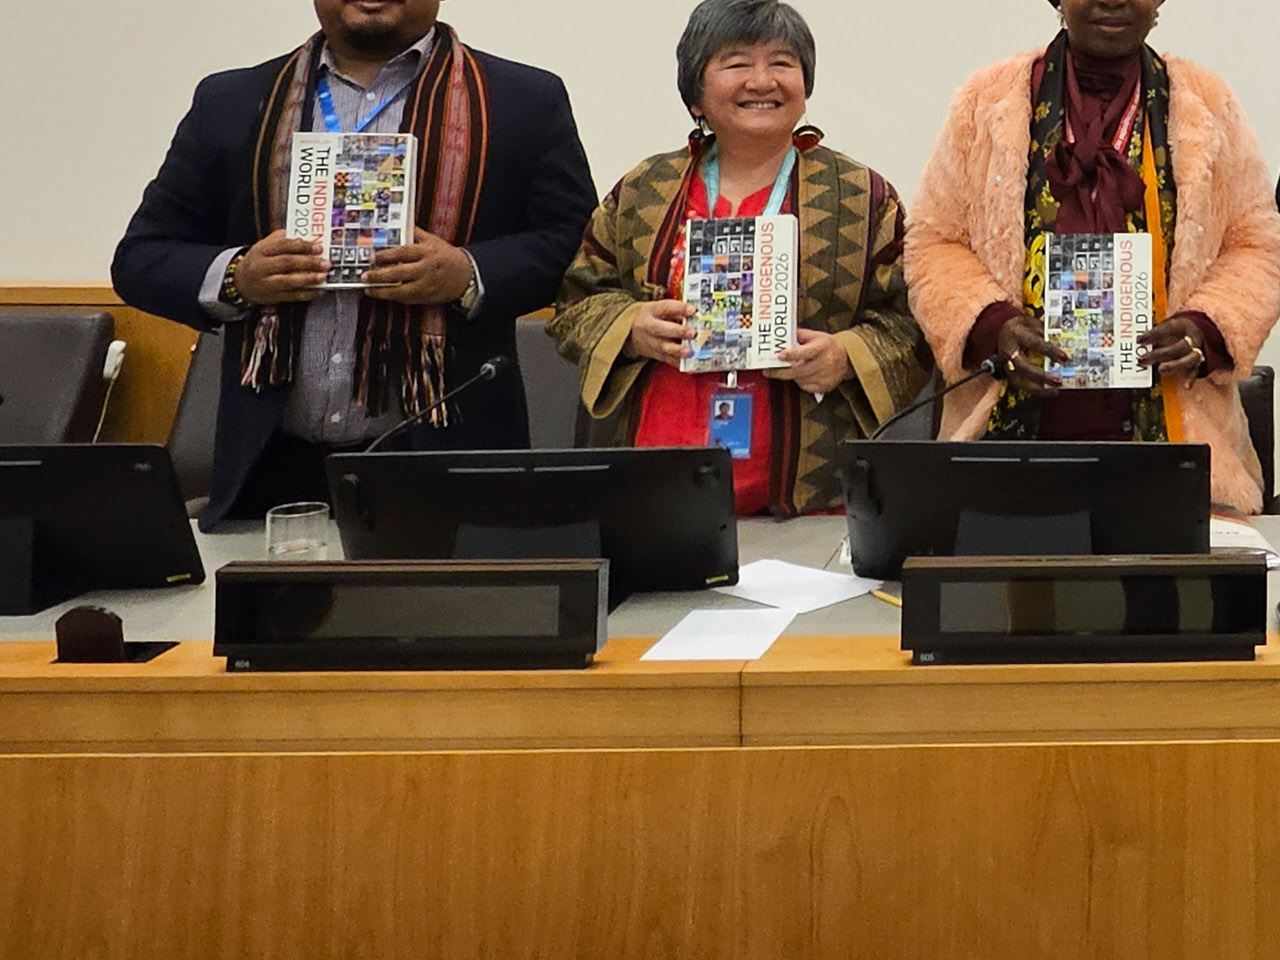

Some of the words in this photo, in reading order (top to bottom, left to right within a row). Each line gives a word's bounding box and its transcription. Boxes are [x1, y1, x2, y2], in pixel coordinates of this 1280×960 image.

[297, 147, 314, 204] WORLD
[315, 147, 331, 177] THE
[294, 208, 310, 238] 202
[311, 180, 328, 245] INDIGEN
[759, 221, 774, 320] INDIGENOUS
[775, 253, 789, 290] 2026
[1120, 240, 1133, 338] INDIGENOUS
[1135, 271, 1148, 310] 2026
[758, 323, 772, 354] THE
[774, 294, 788, 354] WORLD
[1120, 342, 1133, 373] THE
